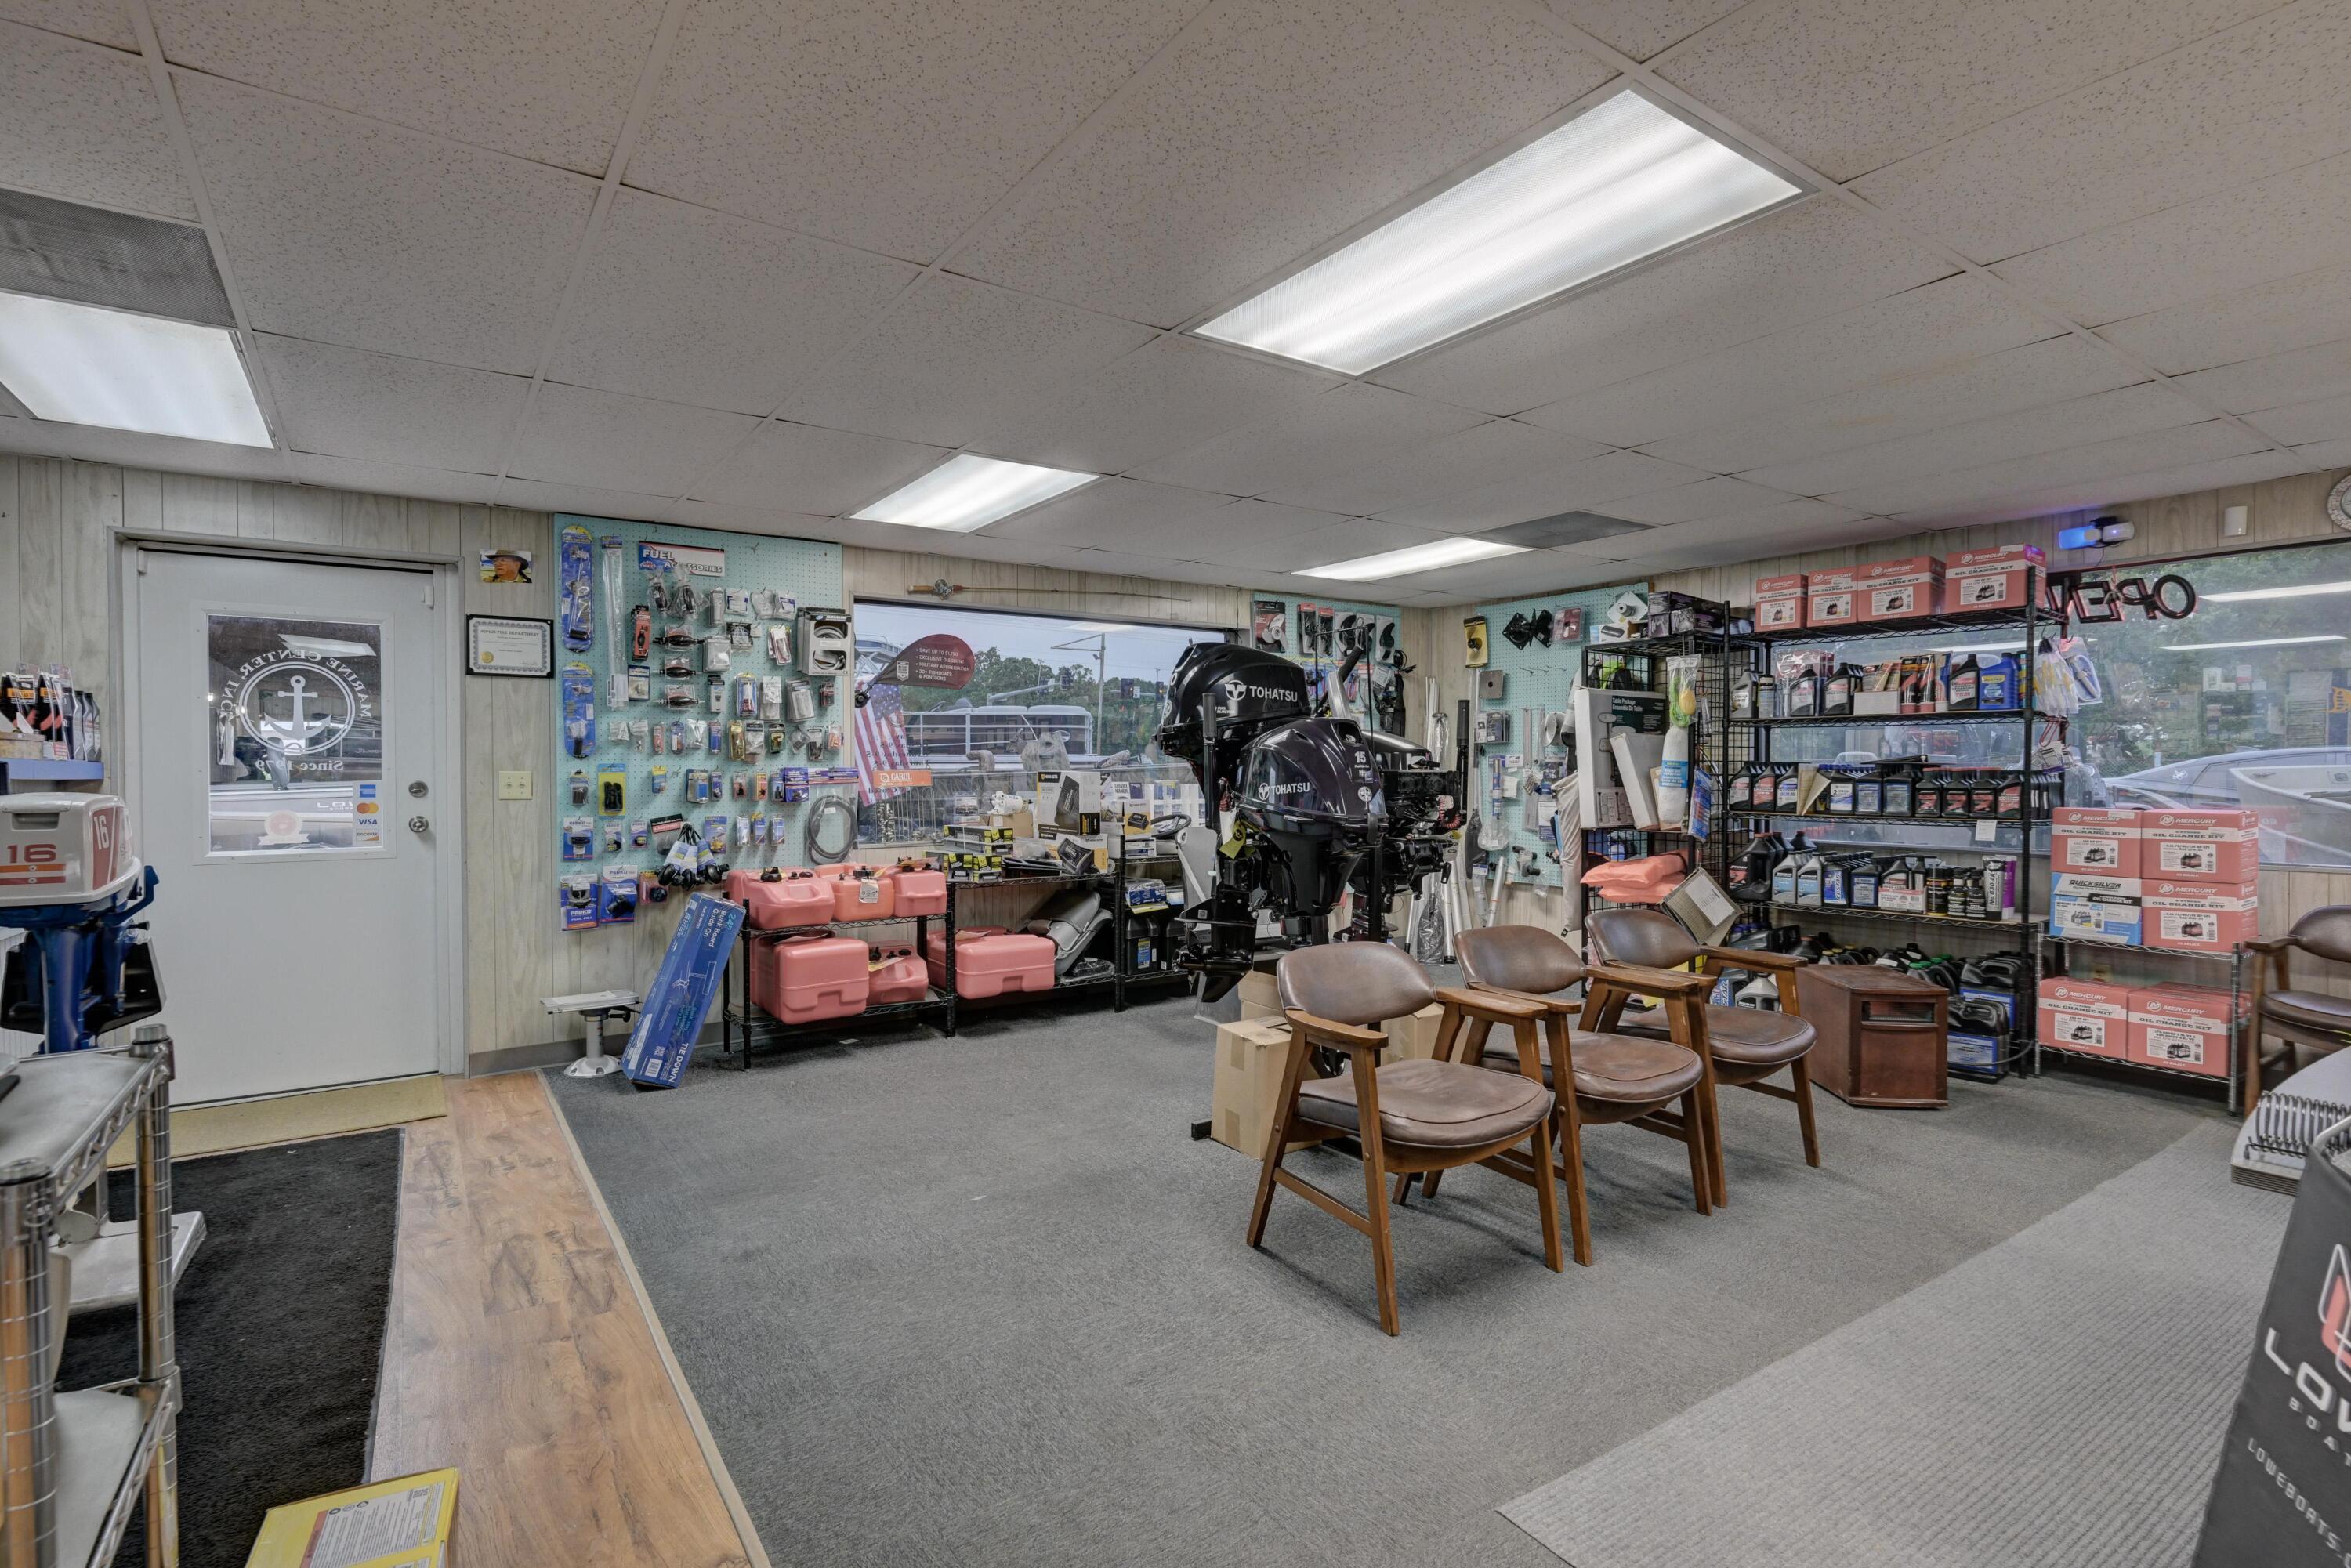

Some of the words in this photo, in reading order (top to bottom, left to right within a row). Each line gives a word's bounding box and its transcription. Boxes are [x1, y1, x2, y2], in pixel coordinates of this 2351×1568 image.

[643, 549, 674, 559] FUEL
[1249, 686, 1298, 702] TOHATSU
[1355, 751, 1367, 763] 15
[1271, 782, 1310, 795] TOHATSU
[93, 815, 110, 850] 16
[7, 844, 57, 864] 16
[2069, 879, 2121, 890] QUICKSILVER
[707, 908, 719, 927] Guide
[715, 910, 726, 928] Bunk
[704, 928, 712, 938] On
[708, 928, 721, 947] Board
[2069, 991, 2107, 1001] MERCURY
[2063, 1005, 2096, 1014] CHANGE
[2163, 1005, 2207, 1015] MERCURY
[2156, 1019, 2193, 1029] CHANGE
[677, 1042, 688, 1056] TIE
[668, 1056, 684, 1083] DOWN
